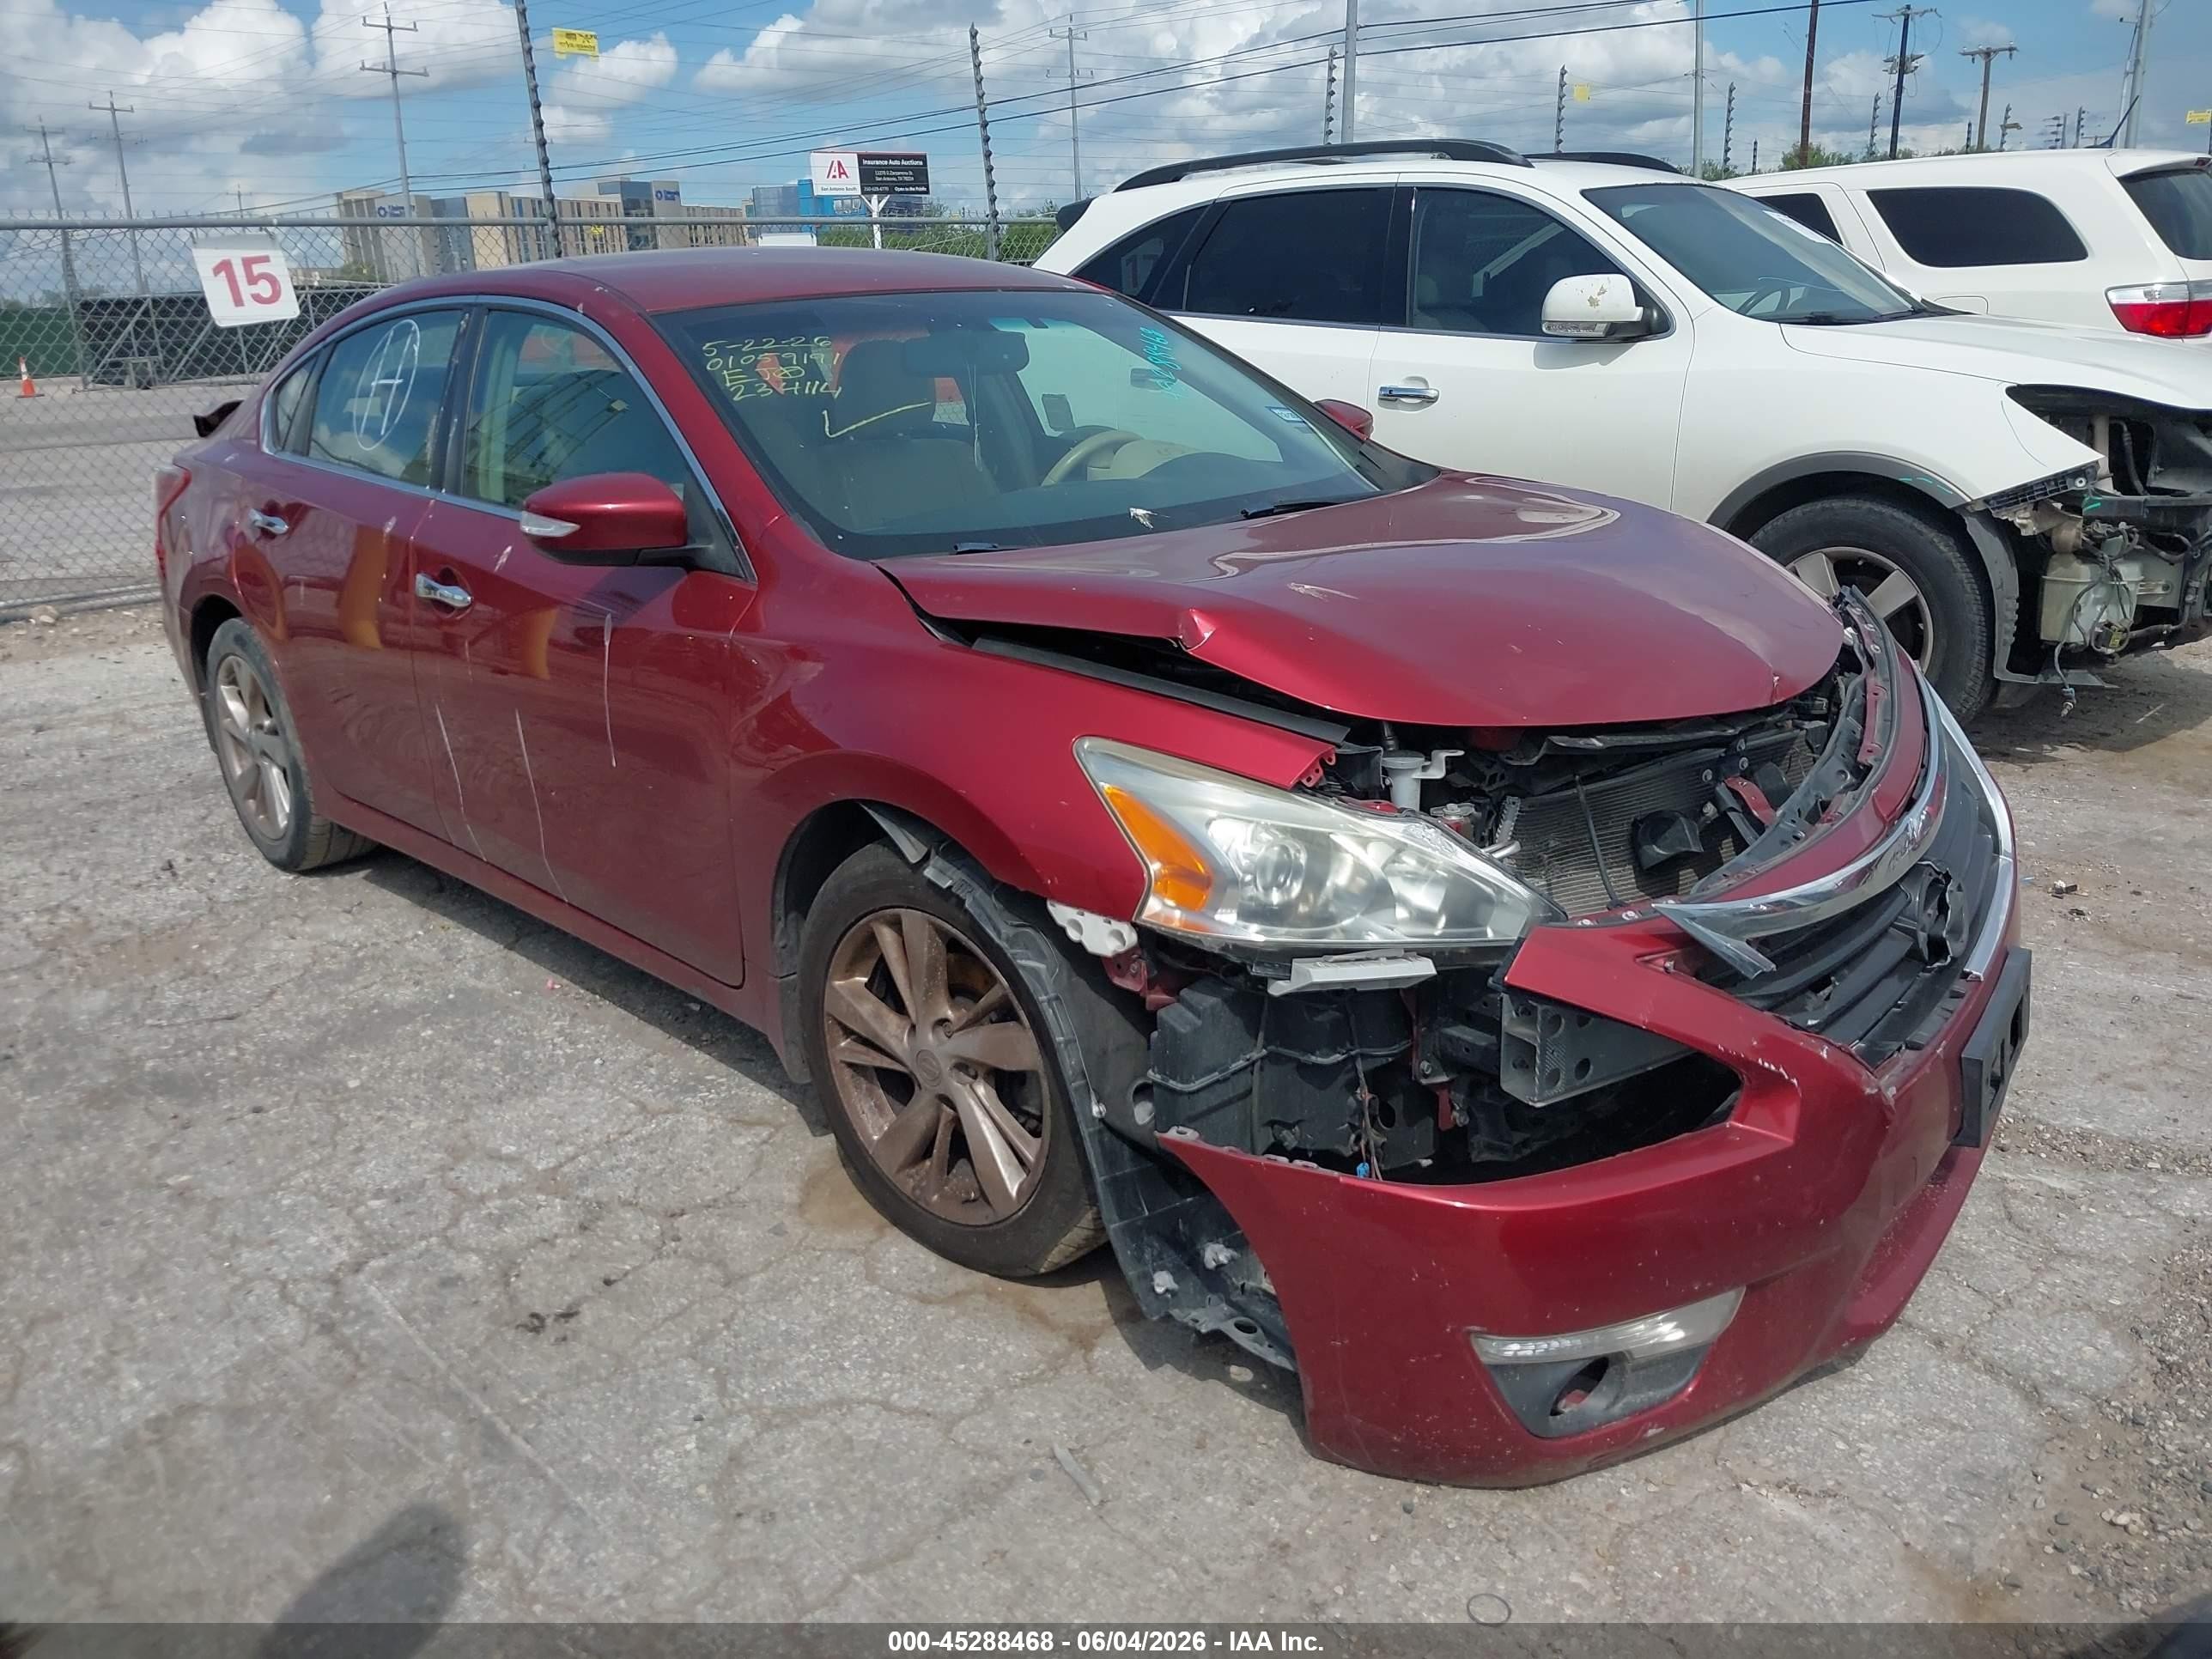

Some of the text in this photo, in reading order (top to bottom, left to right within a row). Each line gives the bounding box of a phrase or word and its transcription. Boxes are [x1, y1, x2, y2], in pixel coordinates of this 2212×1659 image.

[211, 254, 282, 307] 15
[702, 336, 832, 357] 5-22-26
[706, 352, 841, 371] 01059191
